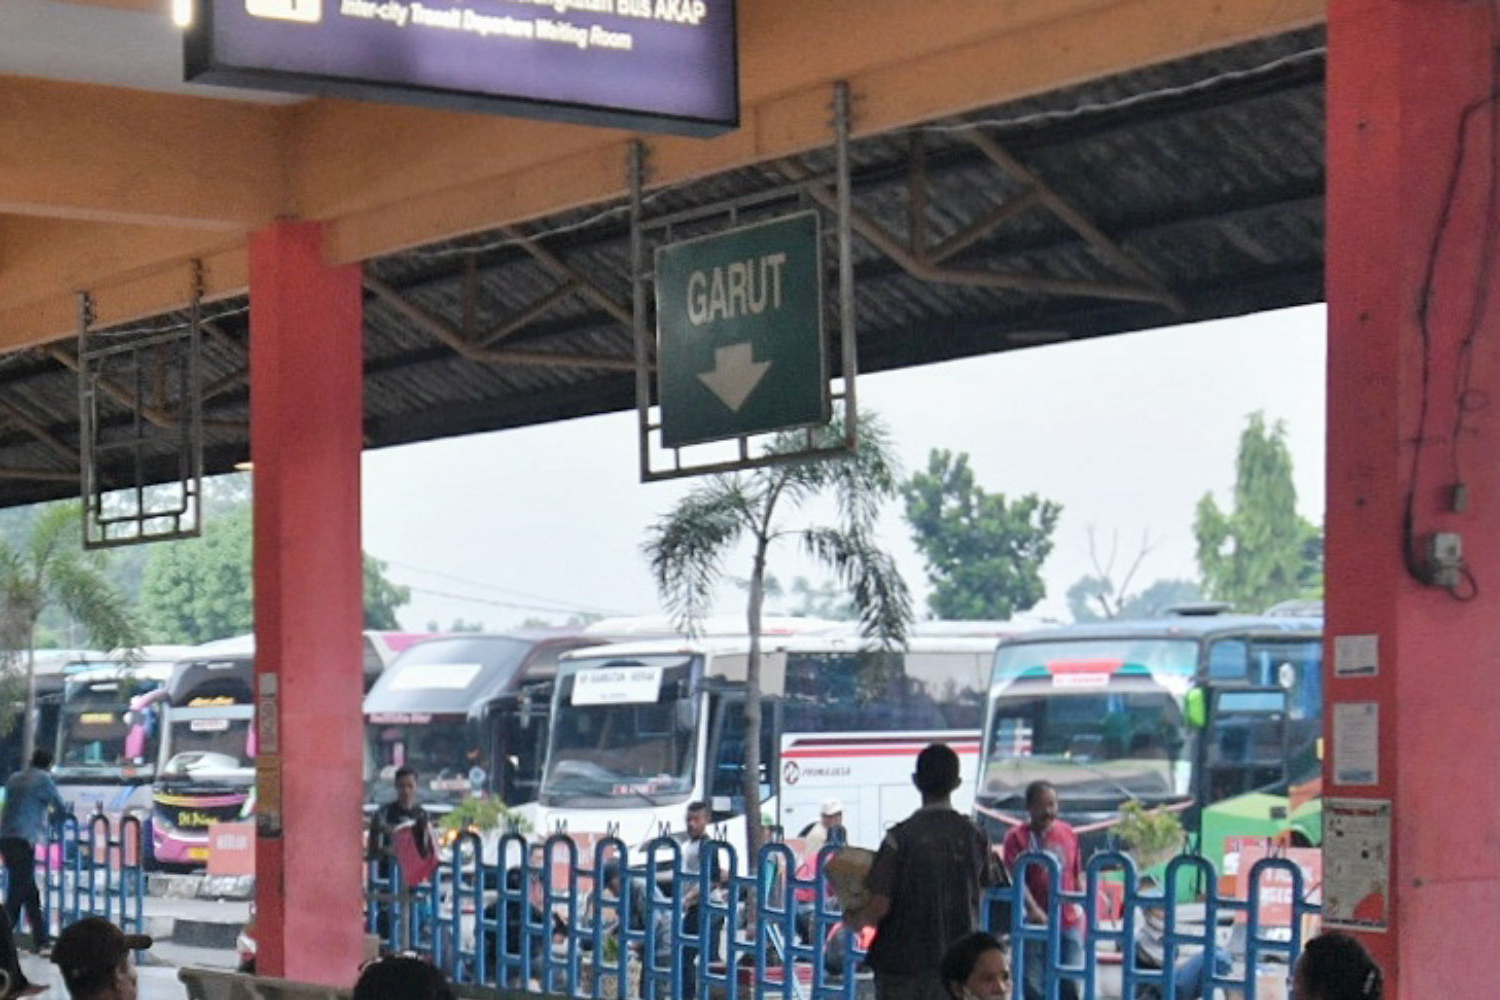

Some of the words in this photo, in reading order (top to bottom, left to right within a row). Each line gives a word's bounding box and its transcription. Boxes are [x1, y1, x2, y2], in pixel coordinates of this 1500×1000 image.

[340, 0, 408, 27] Inter-city
[410, 2, 462, 29] Transit
[462, 8, 534, 38] Departure
[535, 18, 588, 49] Waiting
[589, 25, 633, 50] Room
[653, 0, 707, 25] AKAP
[687, 253, 787, 326] GARUT
